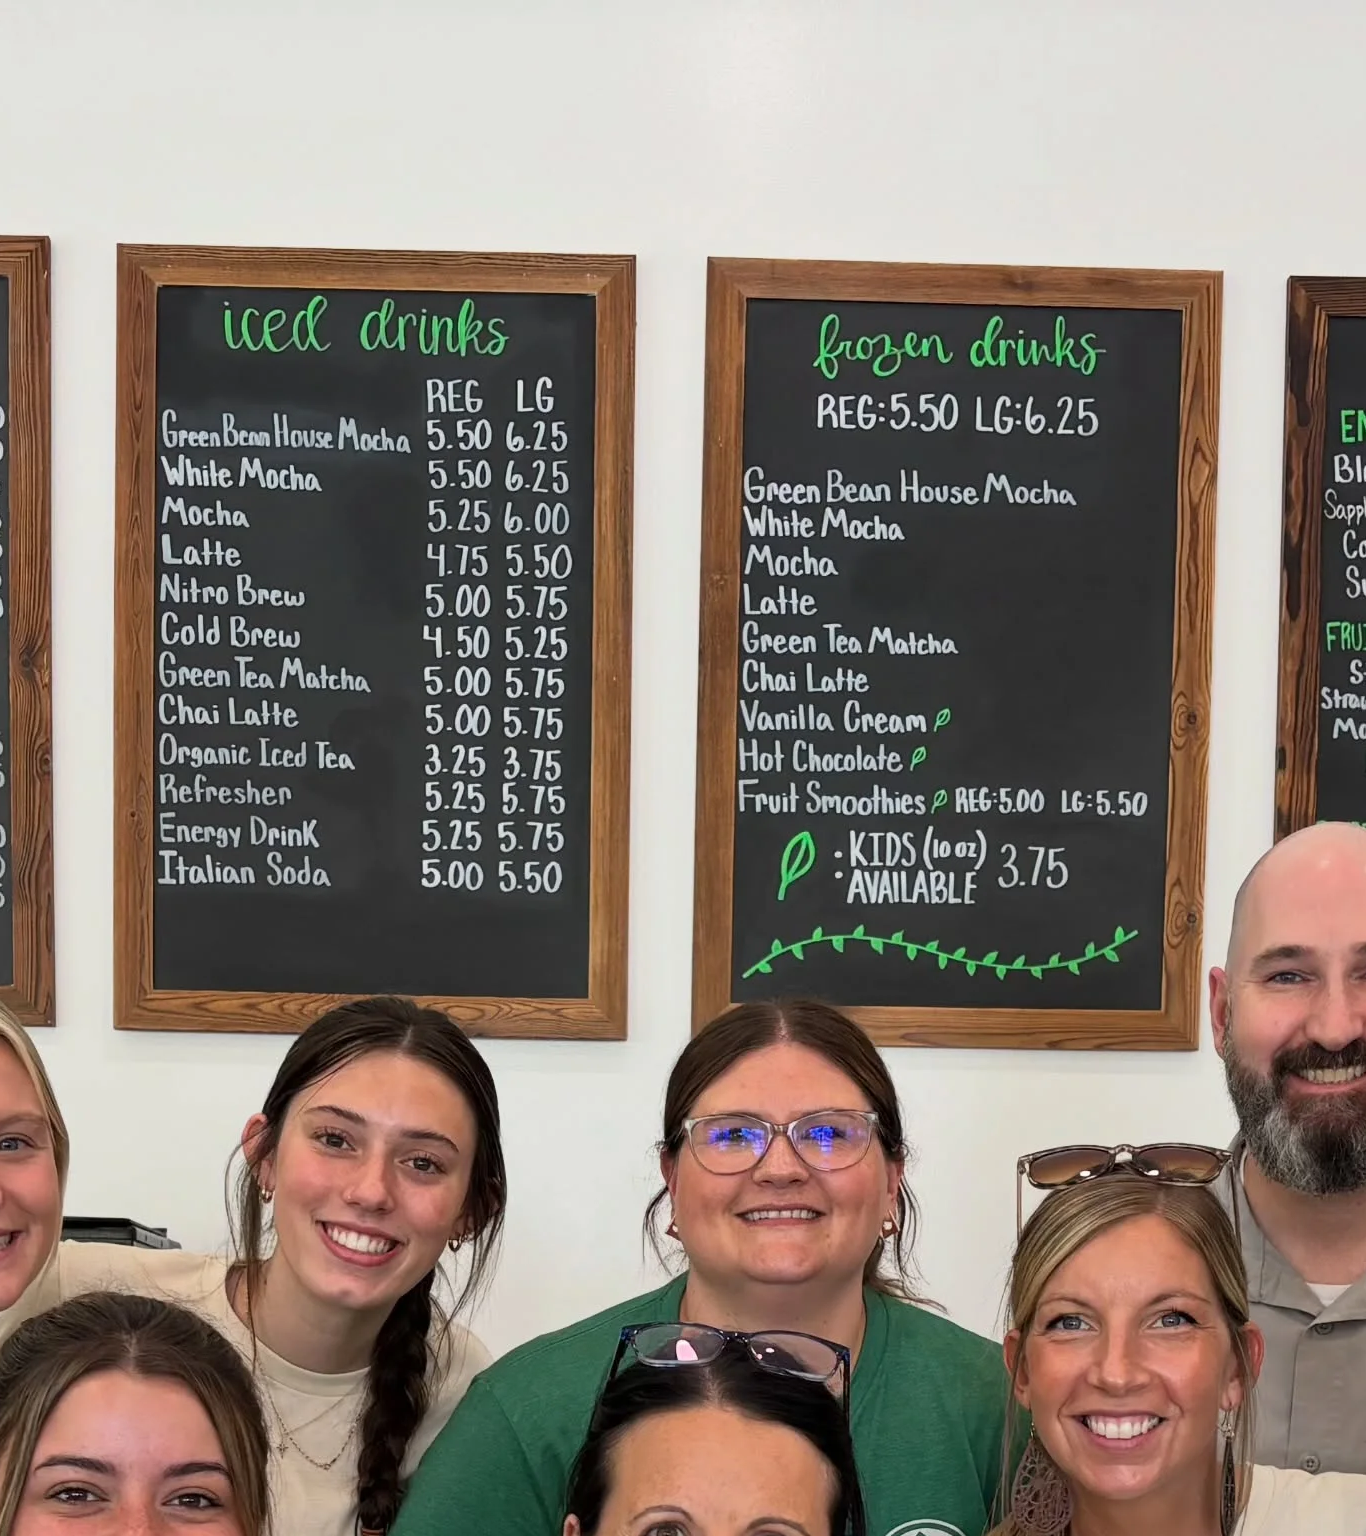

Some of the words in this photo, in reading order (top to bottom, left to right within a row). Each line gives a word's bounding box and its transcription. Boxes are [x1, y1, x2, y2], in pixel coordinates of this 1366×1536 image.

[223, 295, 332, 353] iced
[359, 298, 510, 357] drinks
[812, 313, 954, 380] frozen
[969, 315, 1107, 376] drinks
[426, 378, 484, 414] REG
[516, 376, 555, 413] LG
[160, 453, 234, 488] White
[238, 456, 323, 492] Mocha
[428, 459, 492, 490] 5.50
[504, 459, 569, 494] 6.25
[159, 572, 229, 605] Nitro
[236, 573, 306, 607] Brew
[425, 583, 491, 618] 5.00
[505, 584, 568, 621] 5.75
[739, 699, 835, 732] Vanilla
[843, 699, 927, 734] Cream
[738, 778, 800, 814] Fruit
[805, 780, 927, 816] Smoothies
[157, 849, 256, 885] Italian
[266, 851, 332, 887] Soda
[420, 858, 484, 891] 5.00
[498, 860, 563, 894] 5.50
[849, 829, 917, 868] KIDS
[954, 829, 987, 871] oz)
[997, 843, 1069, 889] 3.75
[846, 868, 978, 905] AVAILABLE
